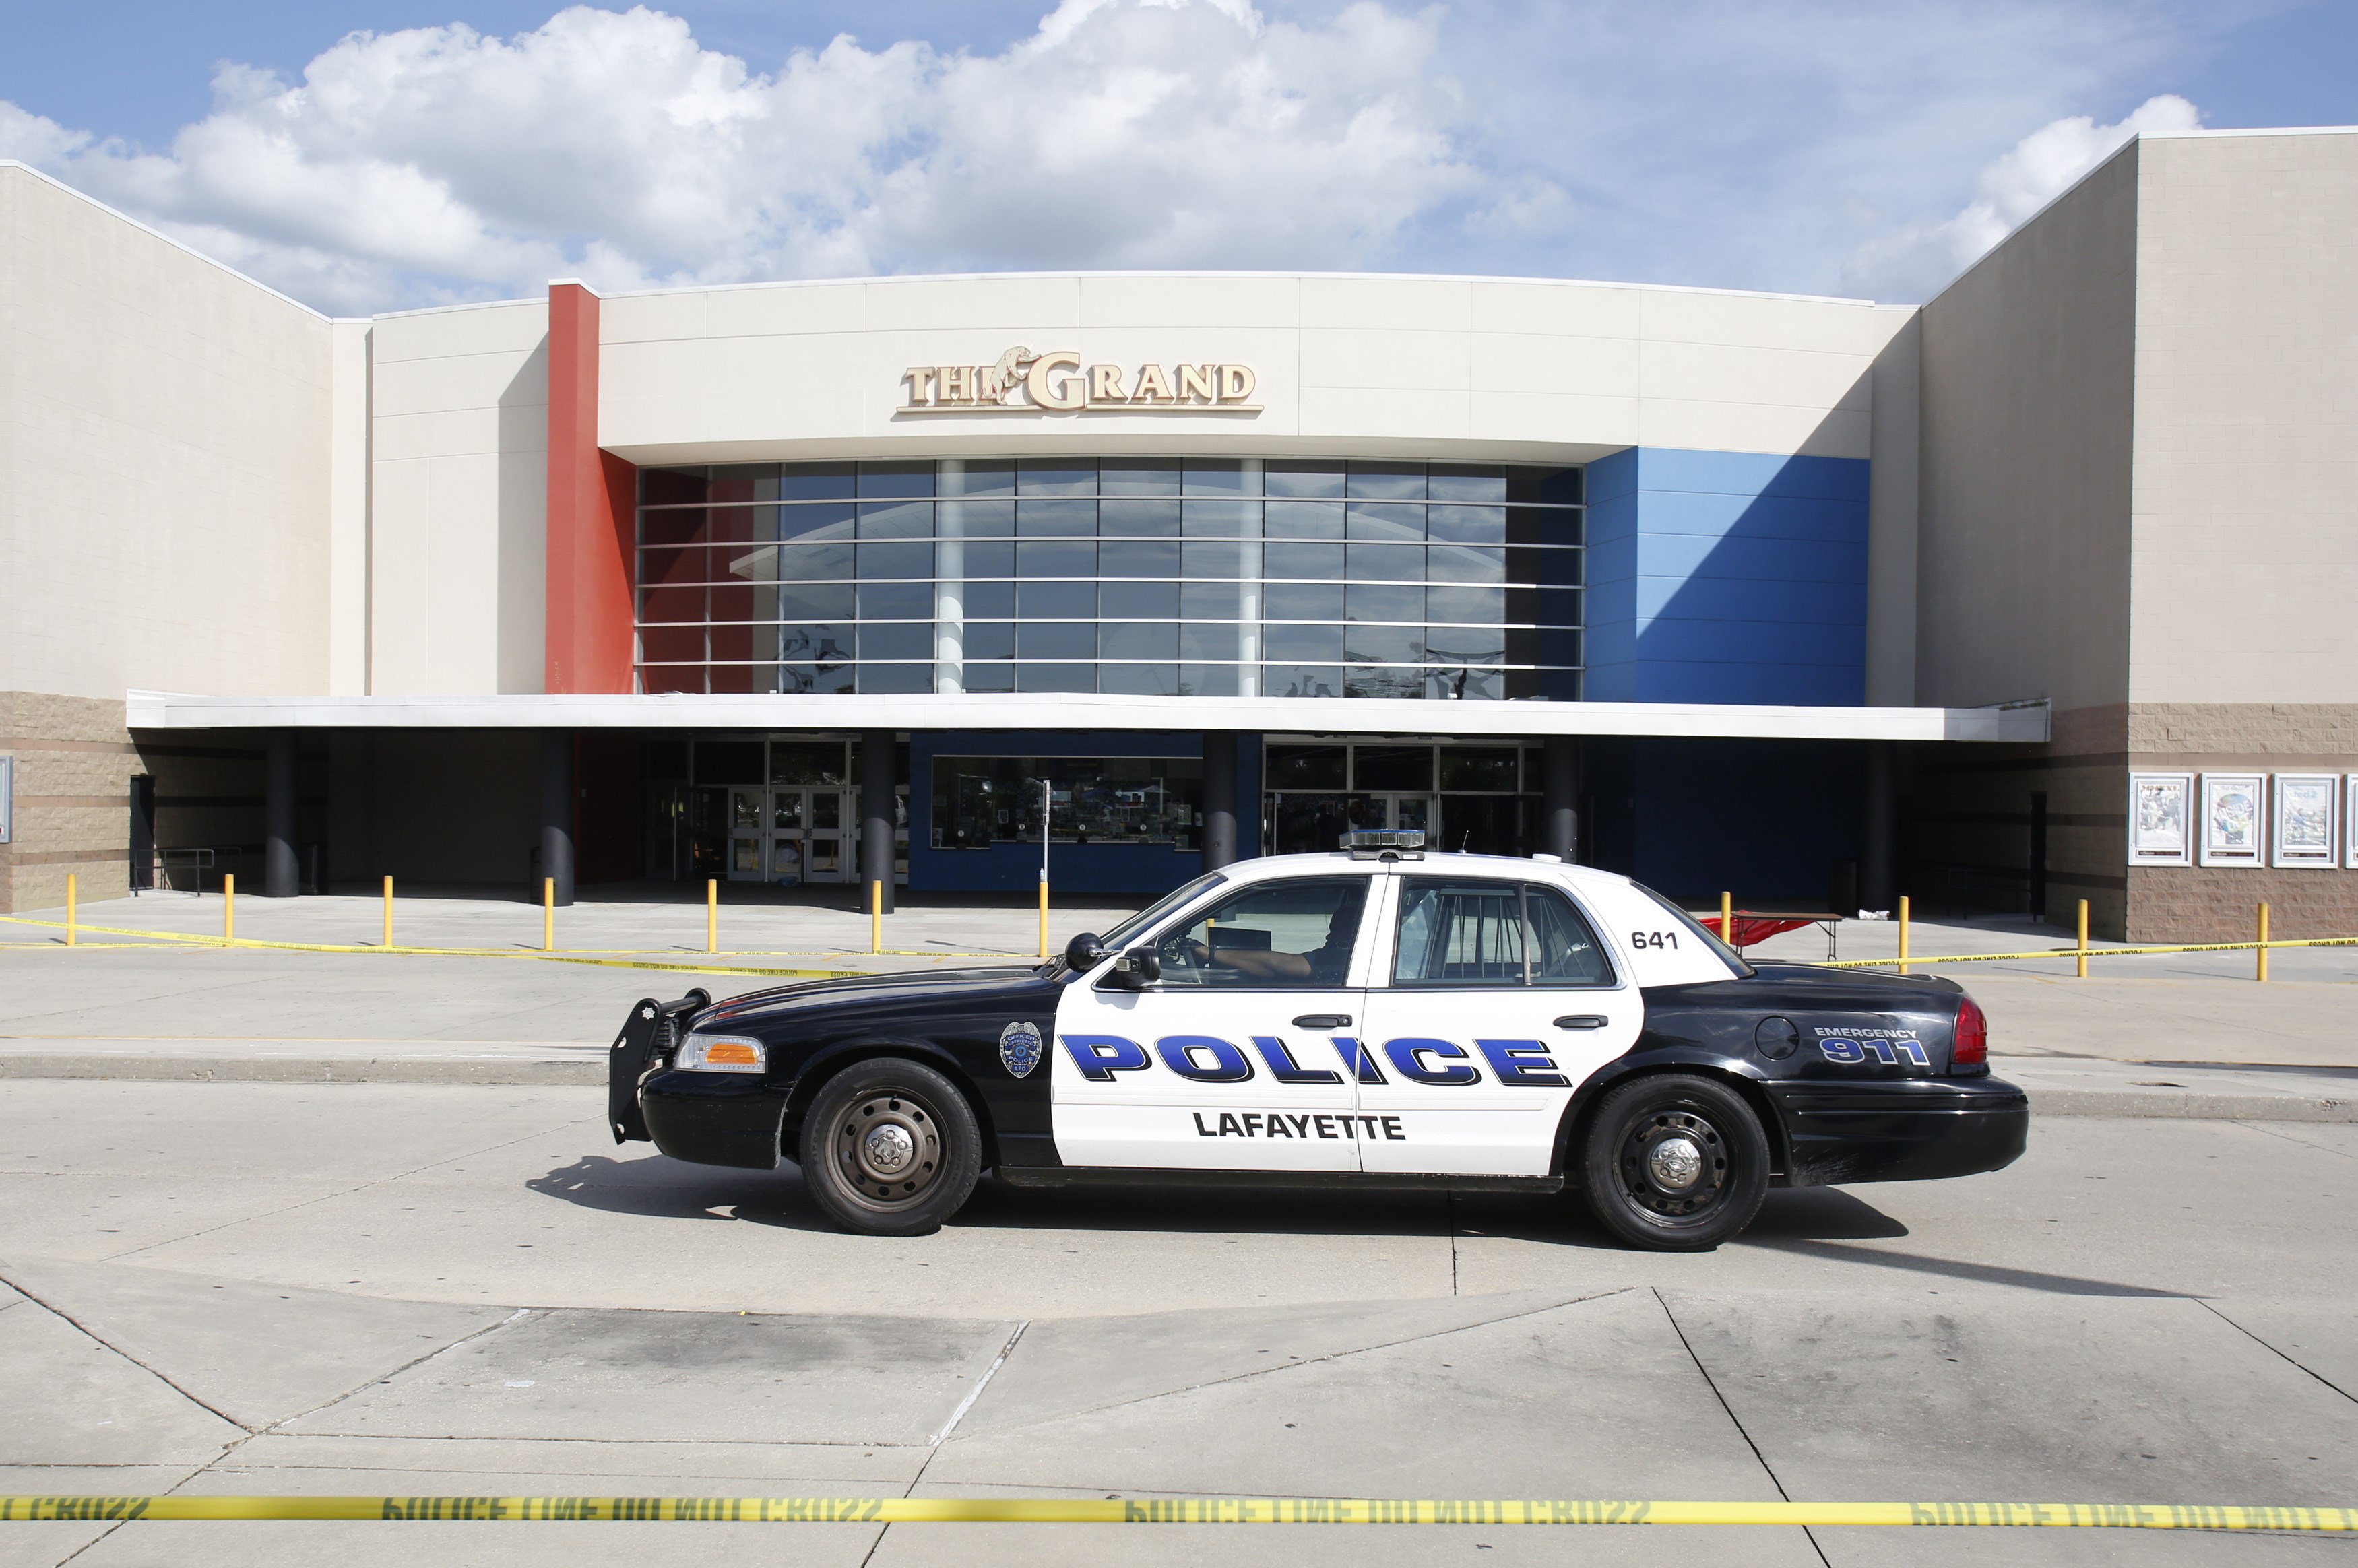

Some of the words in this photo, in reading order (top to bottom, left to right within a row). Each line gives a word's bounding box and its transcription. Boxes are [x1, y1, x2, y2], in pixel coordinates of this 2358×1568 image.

[1027, 351, 1256, 410] GRAND
[1632, 932, 1678, 950] 641
[1814, 1028, 1917, 1039] EMERGENCY
[1056, 1034, 1573, 1087] POLICE
[1818, 1037, 1930, 1066] 911
[1192, 1112, 1406, 1140] LAFAYETTE
